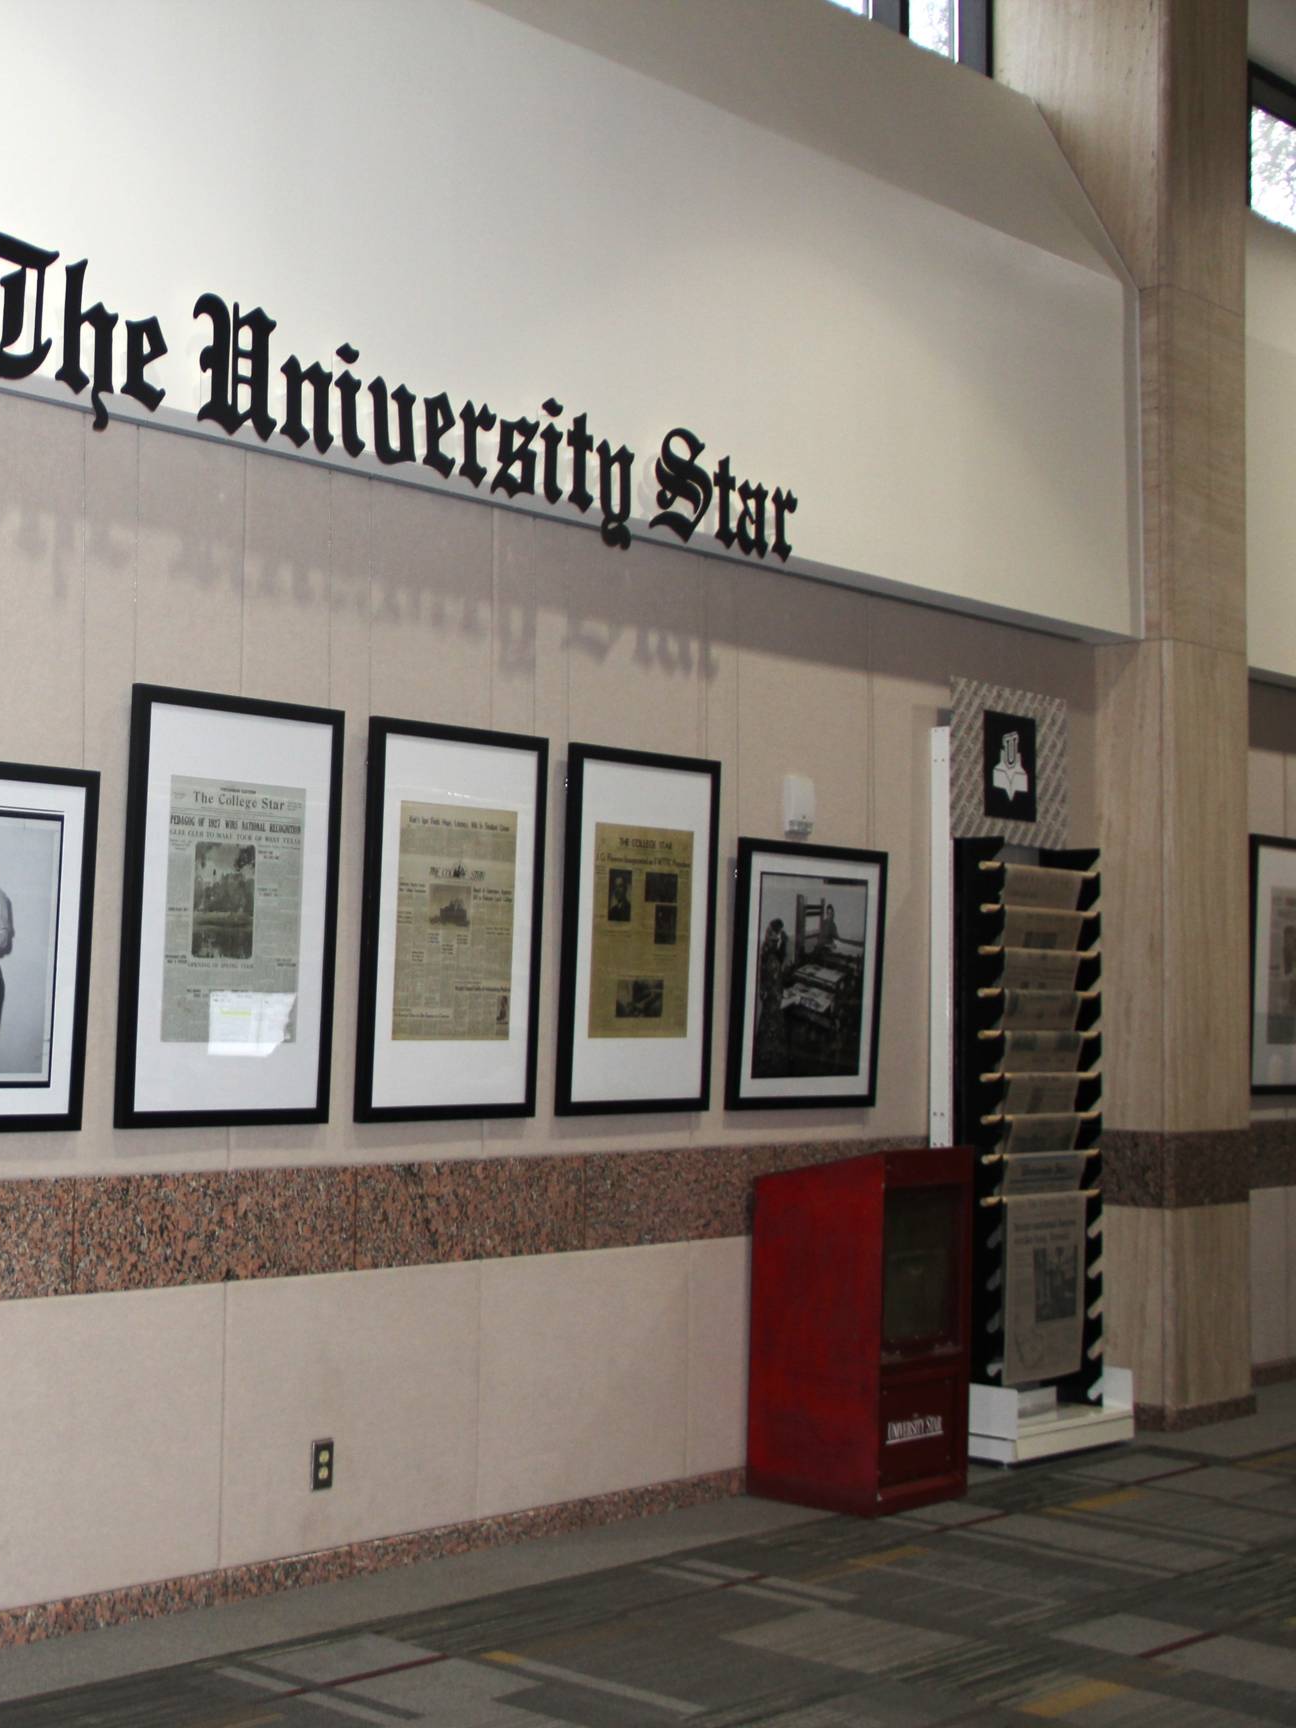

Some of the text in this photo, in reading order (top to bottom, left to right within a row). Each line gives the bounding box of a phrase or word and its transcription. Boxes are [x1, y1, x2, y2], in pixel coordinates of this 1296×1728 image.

[193, 292, 635, 549] University
[649, 427, 798, 562] Star
[193, 790, 214, 804] The
[218, 793, 257, 809] College
[261, 797, 285, 811] Star
